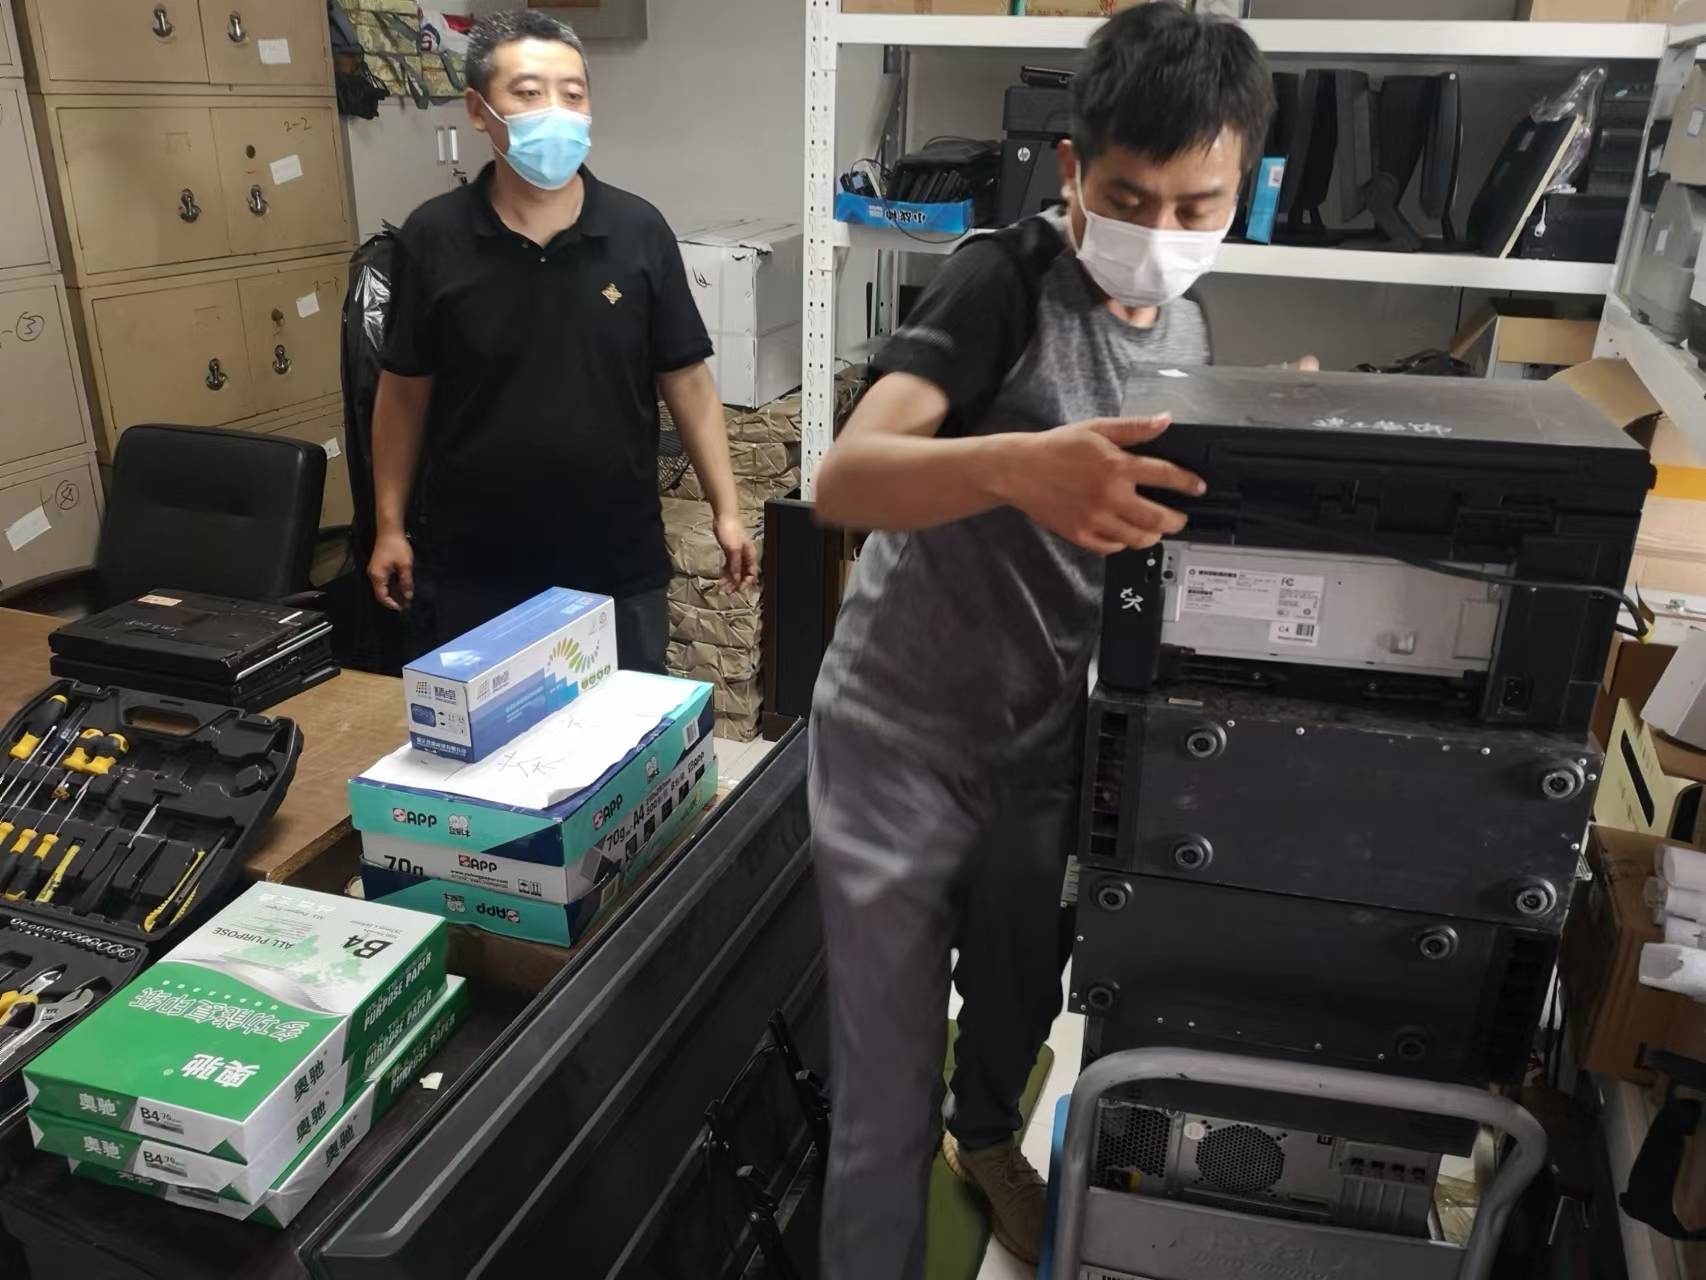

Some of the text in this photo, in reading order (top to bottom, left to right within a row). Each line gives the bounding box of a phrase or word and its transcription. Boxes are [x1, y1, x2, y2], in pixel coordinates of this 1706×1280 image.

[407, 810, 438, 828] APP
[603, 793, 624, 822] APP
[633, 803, 645, 830] A4
[470, 858, 498, 873] APP
[476, 903, 508, 921] APP
[212, 926, 295, 951] ALL PURPOSE
[342, 934, 392, 959] B4
[364, 951, 432, 1032] PURPOSE PAPER
[128, 986, 311, 1042] 多功能复印纸
[181, 1053, 261, 1088] 奥驰
[294, 1060, 326, 1103] 奥驰
[79, 1092, 118, 1117] 奥驰
[140, 1106, 160, 1122] B4
[296, 1100, 327, 1144] 奥驰
[83, 1135, 122, 1160] 奥驰
[143, 1150, 164, 1165] B4
[325, 1124, 355, 1168] 奥驰
